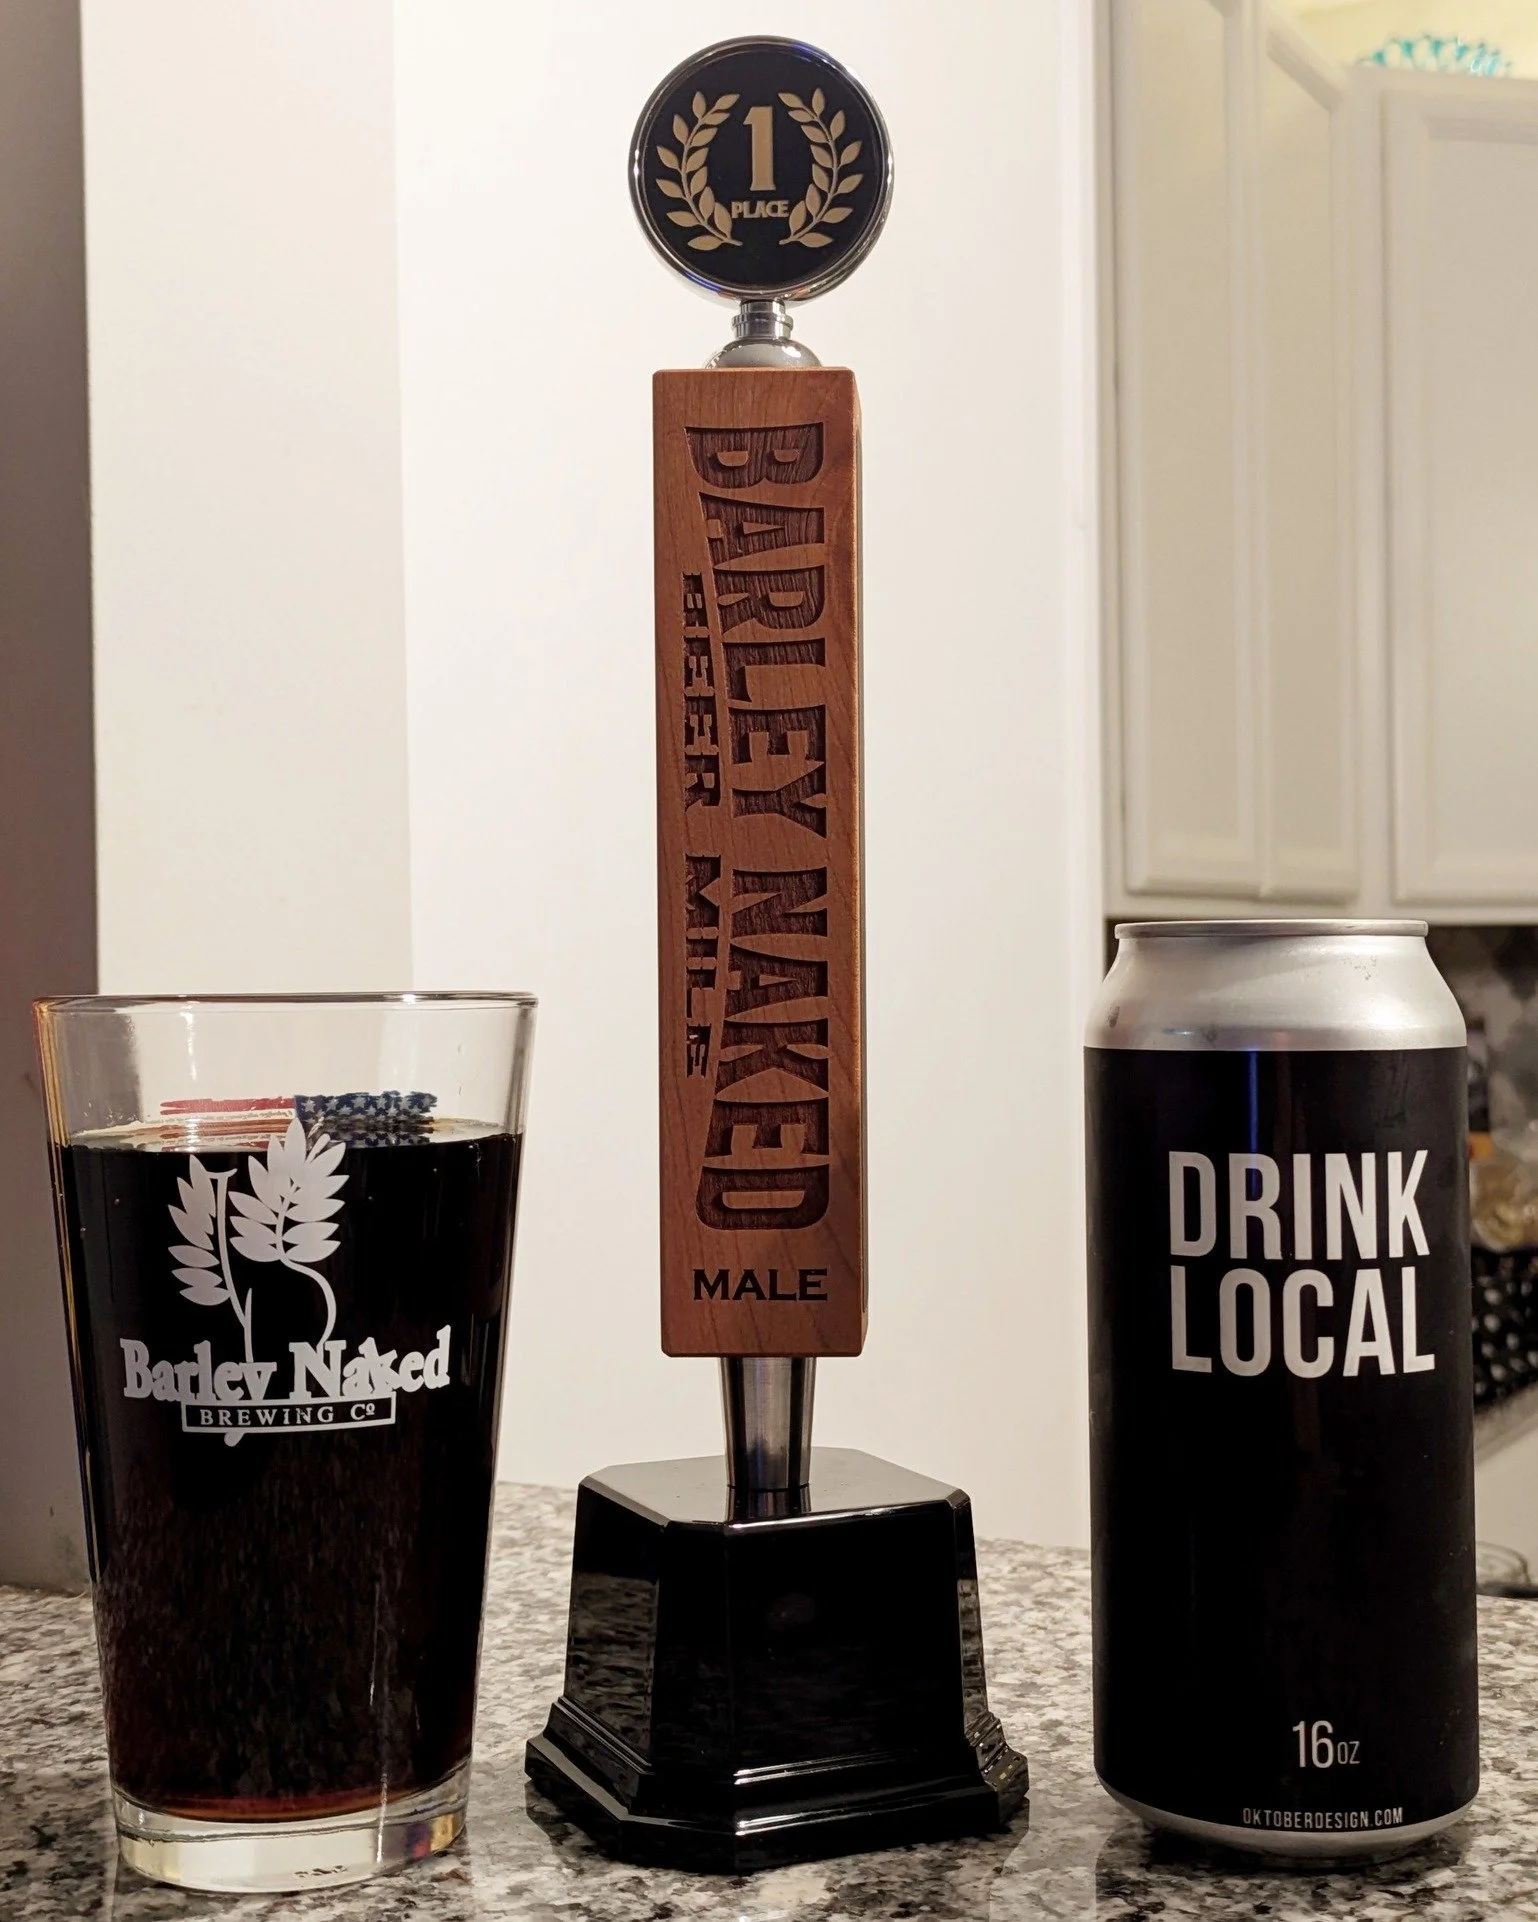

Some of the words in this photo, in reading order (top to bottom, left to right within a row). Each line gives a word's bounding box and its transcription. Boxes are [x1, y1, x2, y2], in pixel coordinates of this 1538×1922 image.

[743, 106, 776, 191] 1
[731, 200, 789, 218] PLACE
[684, 422, 827, 839] BARLEY
[683, 572, 720, 812] BEER
[685, 854, 721, 1078] MILE
[695, 866, 830, 1230] NAKED
[1169, 1149, 1431, 1260] DRINK
[693, 1268, 828, 1301] MALE
[1170, 1265, 1436, 1379] LOCAL
[120, 1337, 277, 1447] Barley
[288, 1324, 451, 1400] Naked
[199, 1406, 335, 1427] BREWING
[1242, 1806, 1404, 1830] OKTOBERDESIGN.COM
